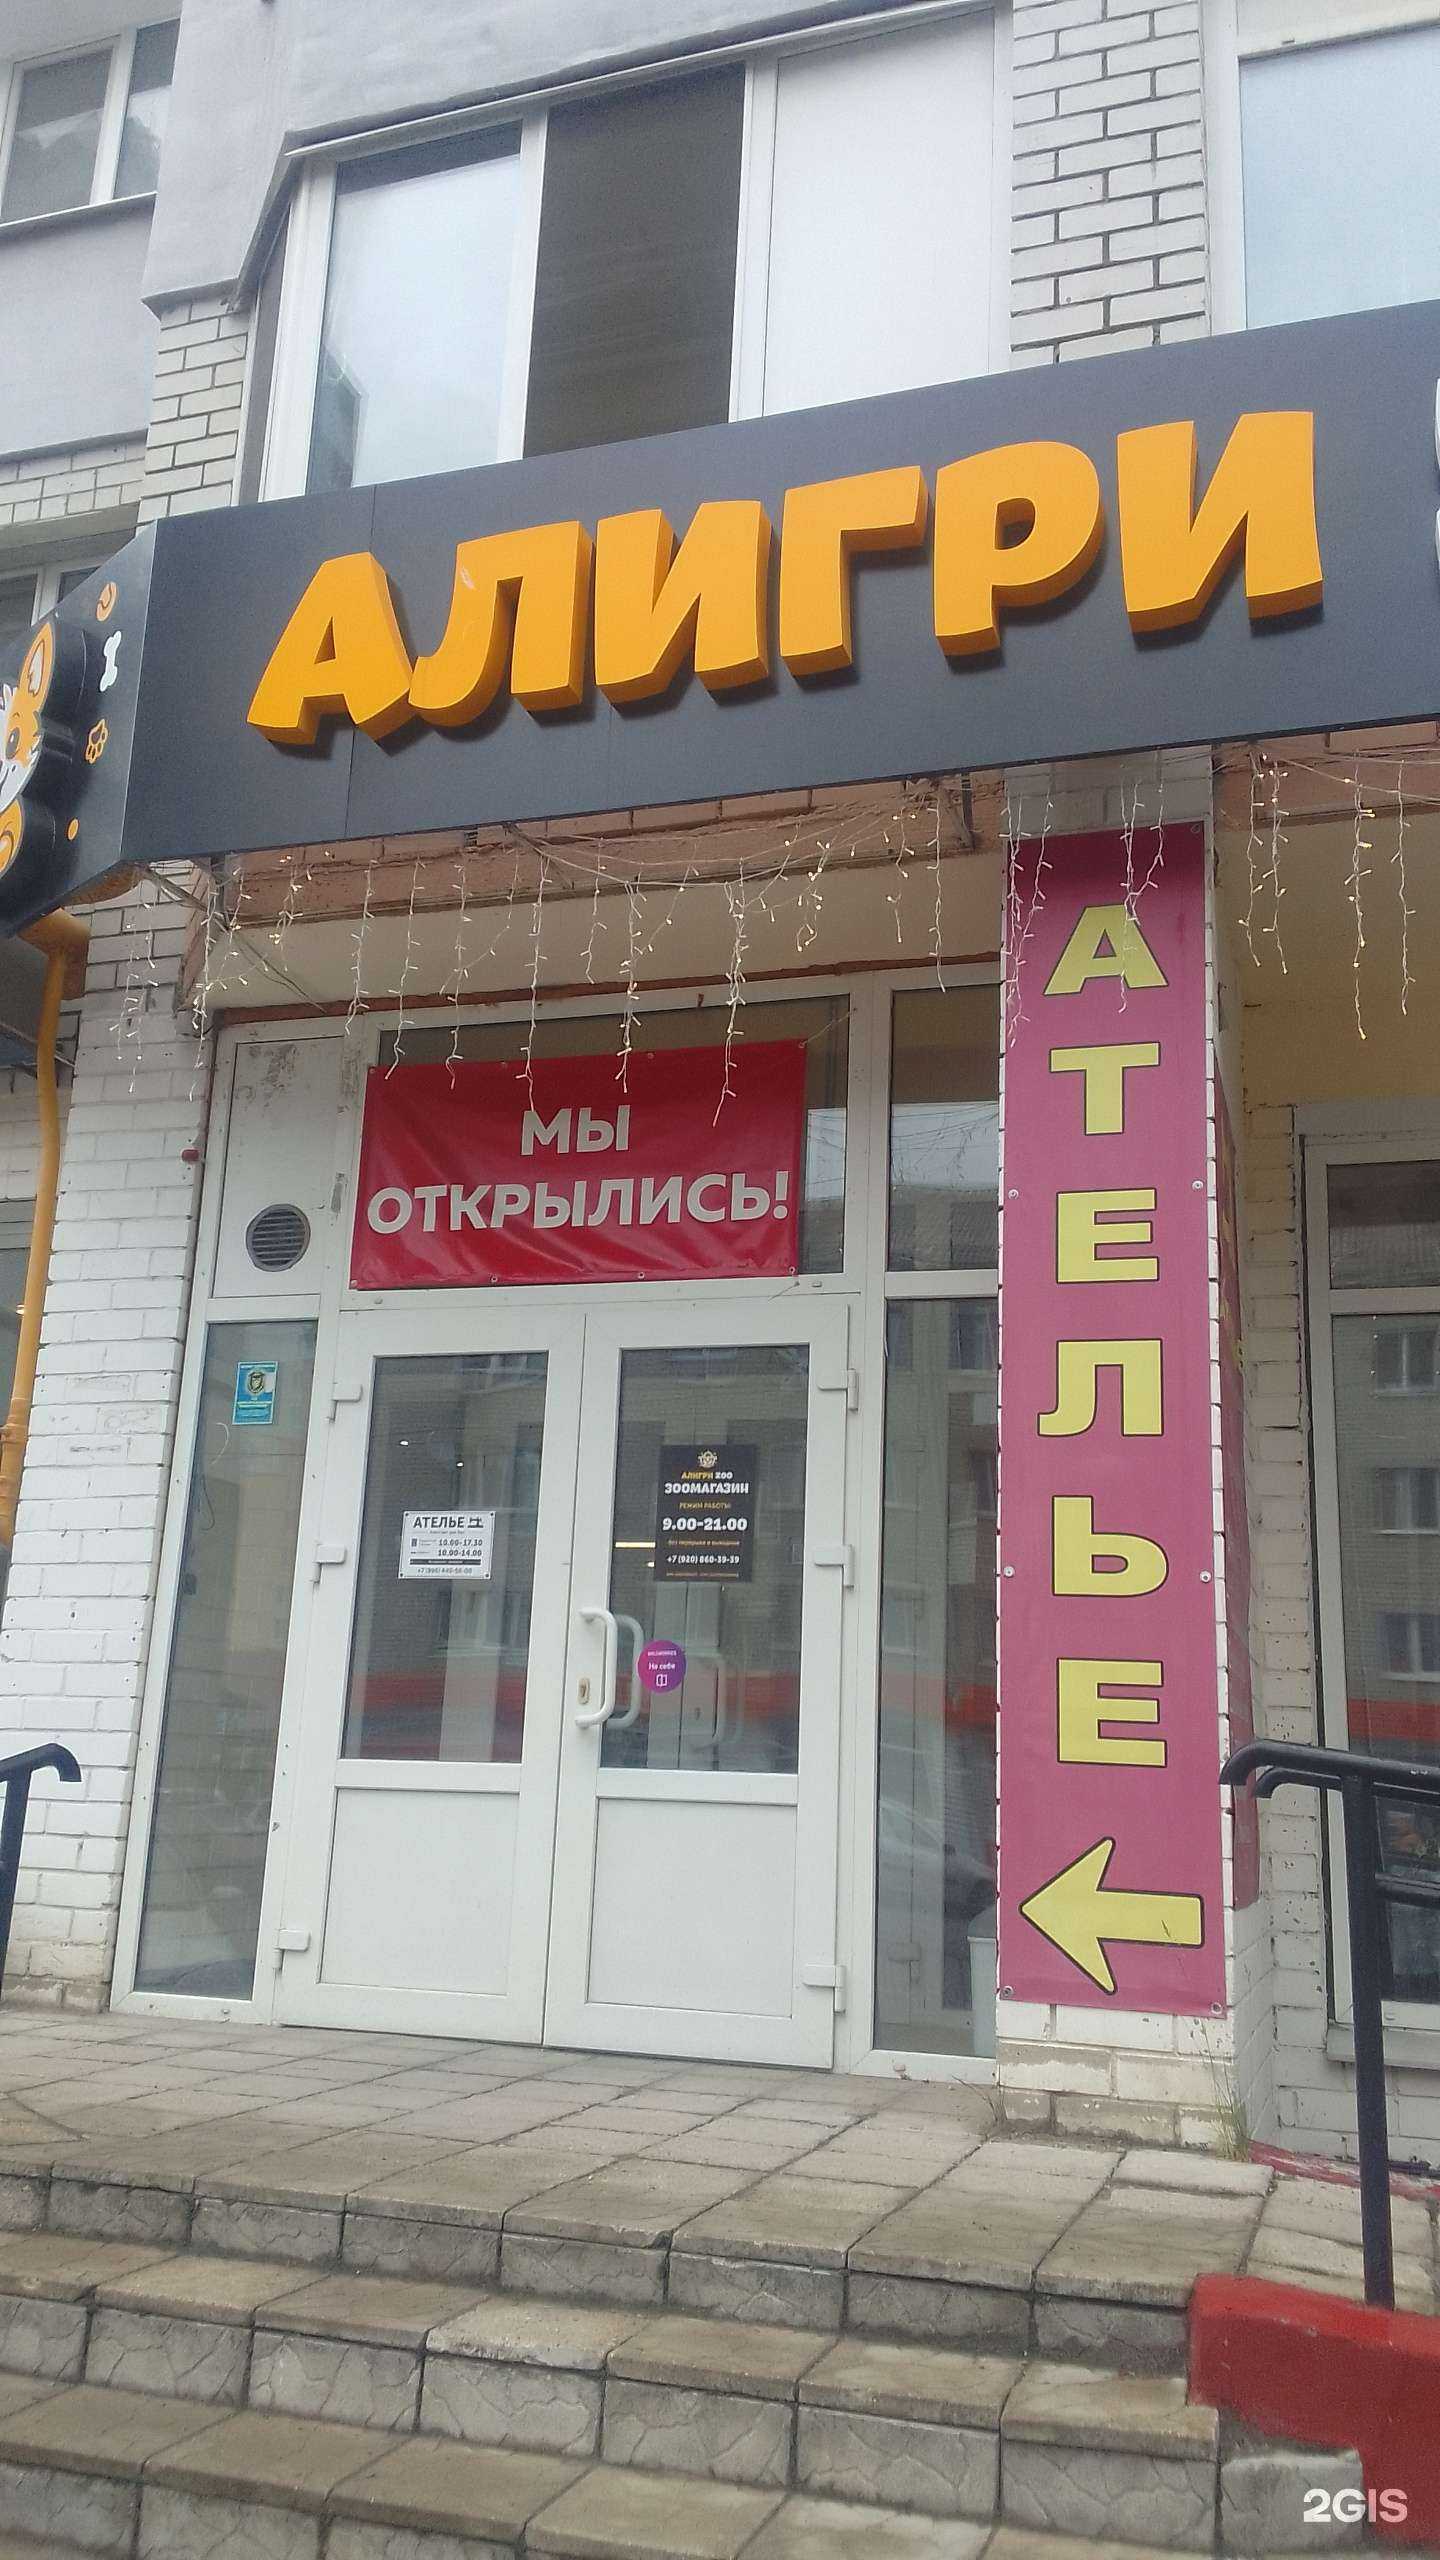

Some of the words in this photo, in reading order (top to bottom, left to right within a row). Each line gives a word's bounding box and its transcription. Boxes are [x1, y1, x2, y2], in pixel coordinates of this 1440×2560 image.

[246, 411, 1323, 745] АЛИГРИ
[520, 1104, 632, 1157] МЫ
[366, 1170, 790, 1235] ОТКРЫЛИСЬ!
[1037, 903, 1169, 1768] АТЕЛЬЕ
[681, 1471, 714, 1480] АЛИГРИ
[664, 1482, 749, 1494] ЗООМАГАЗИН
[413, 1516, 465, 1528] АТЕЛЬЕ
[662, 1517, 748, 1531] 9.00-21.00
[438, 1538, 483, 1547] 10.00-17.30
[438, 1549, 482, 1557] 10.00-14.00
[666, 1554, 677, 1564] +7
[677, 1554, 698, 1564] (920)
